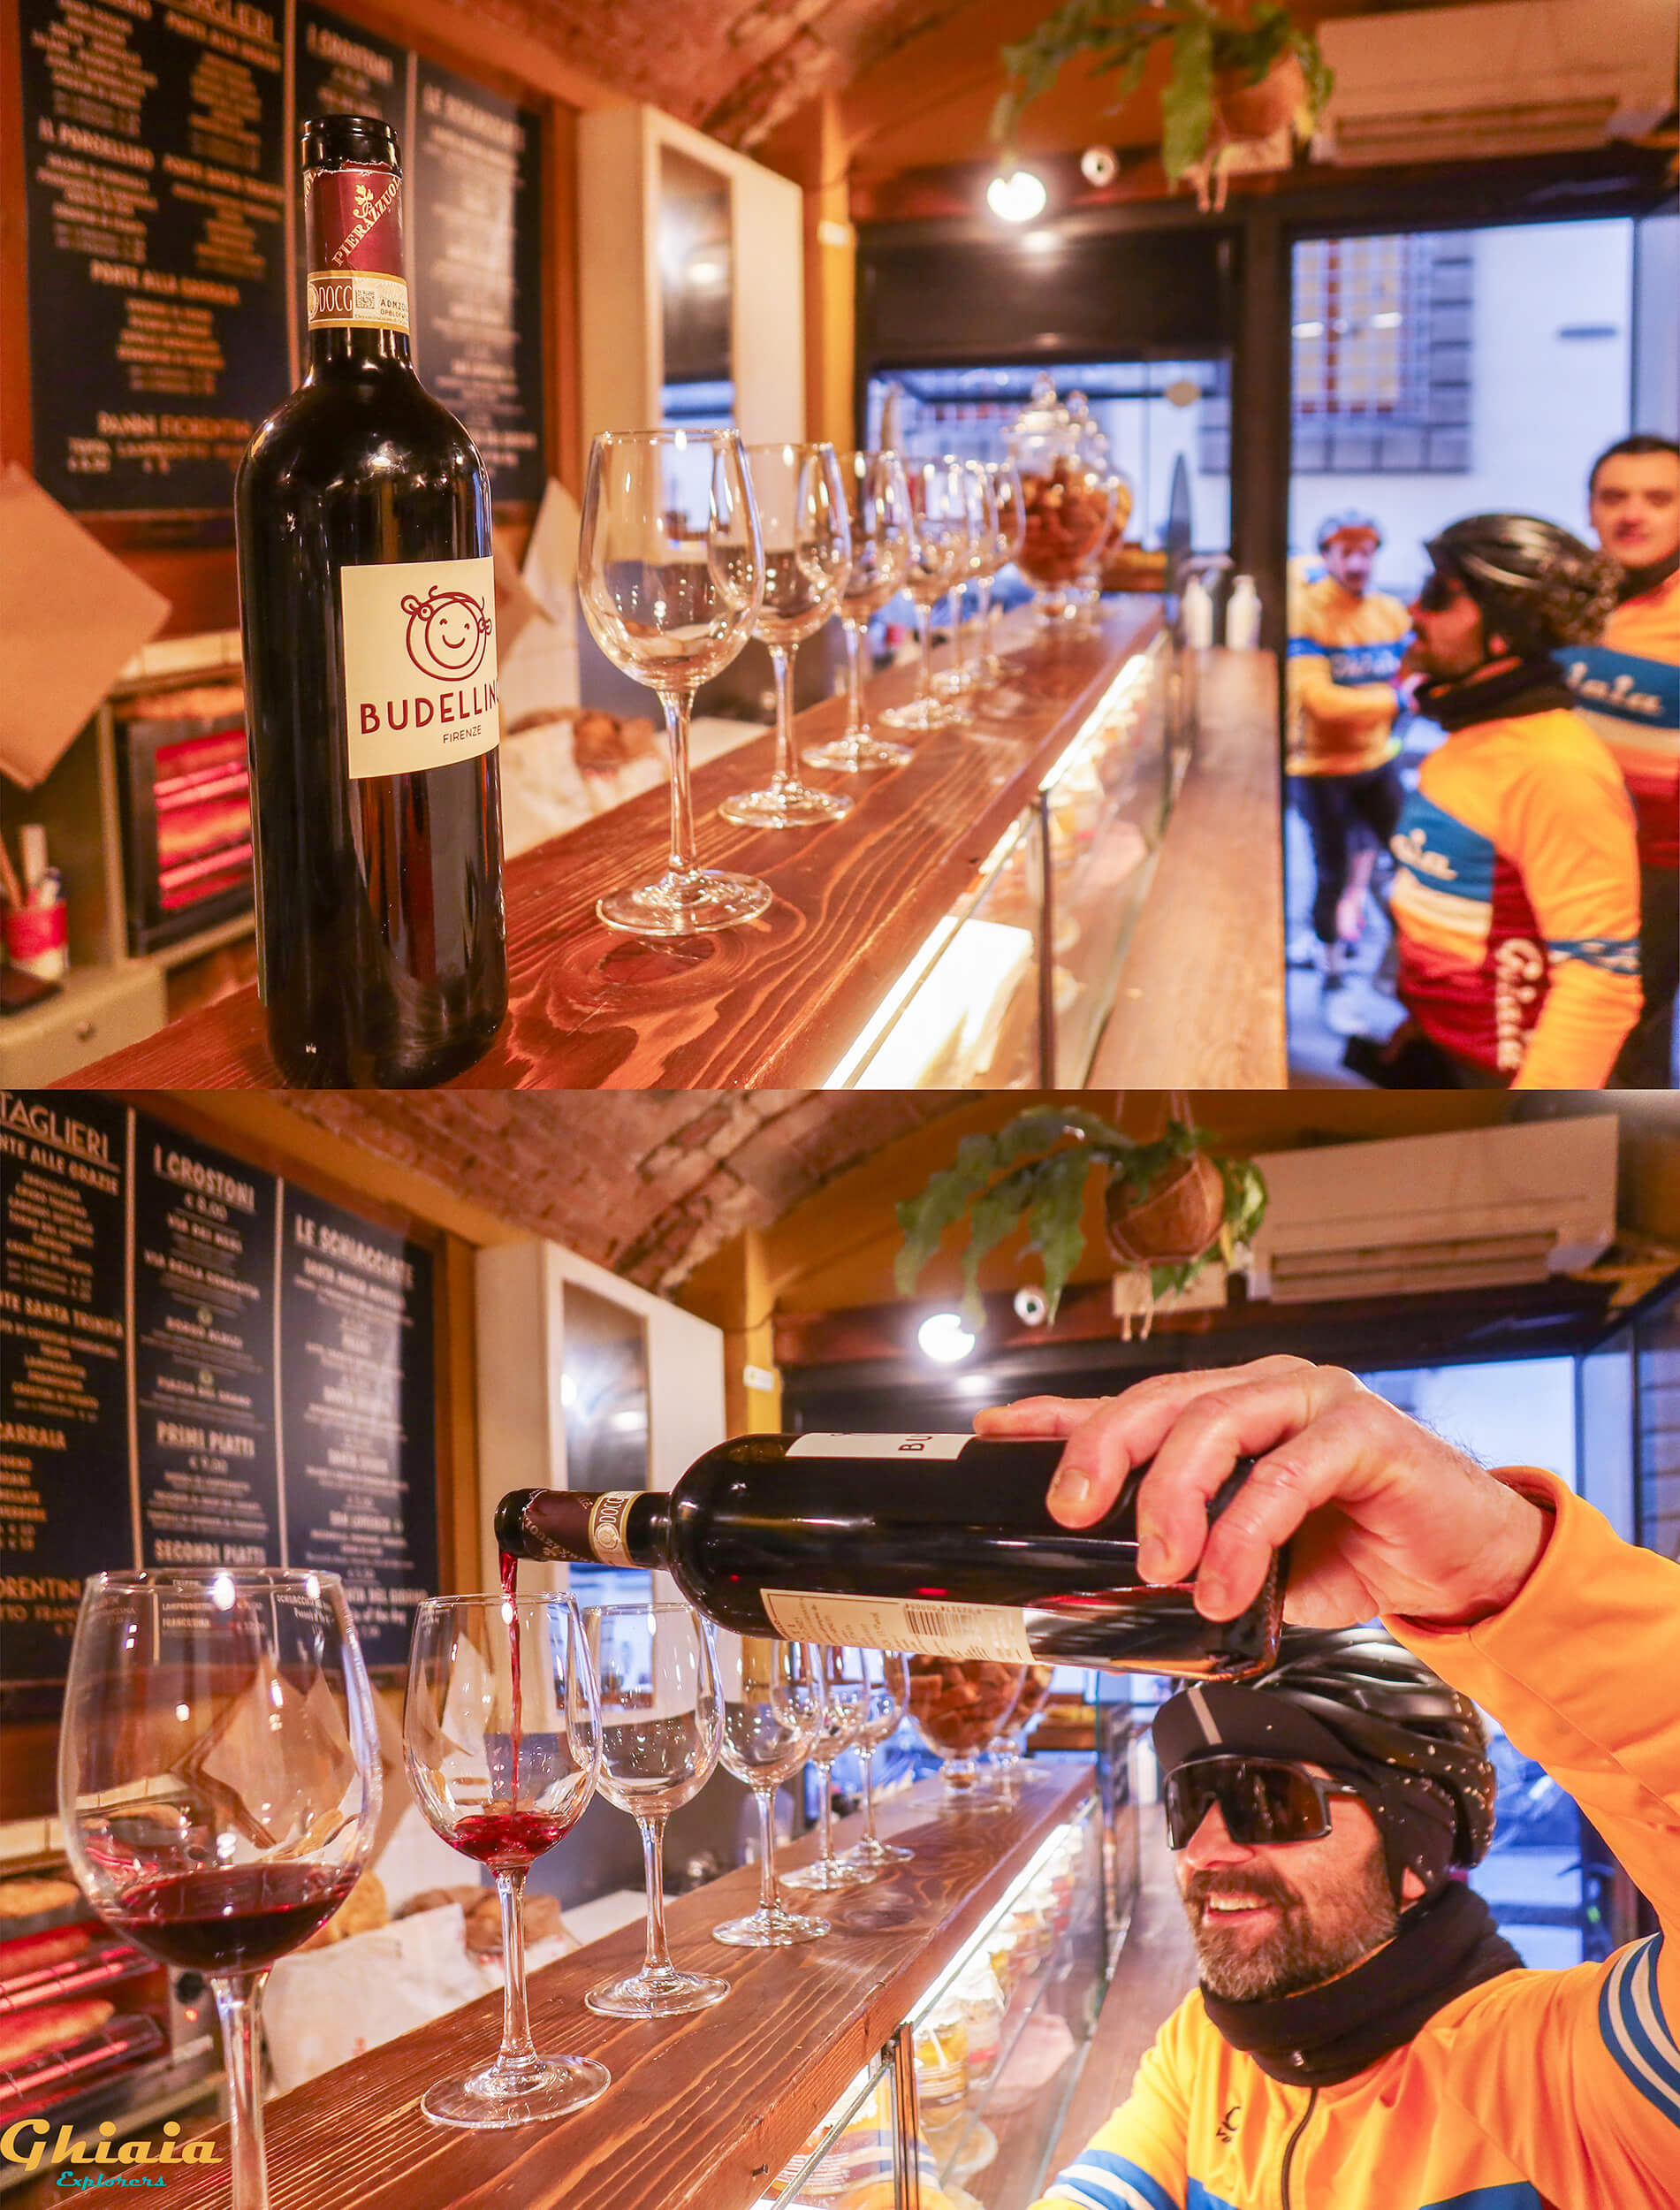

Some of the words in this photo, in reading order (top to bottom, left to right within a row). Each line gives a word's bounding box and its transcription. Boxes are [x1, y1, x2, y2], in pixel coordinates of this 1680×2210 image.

[318, 285, 353, 312] DOCG
[361, 679, 498, 735] BUDELLIN
[443, 724, 482, 743] FIRENZE
[167, 1151, 255, 1212] CROSTONI
